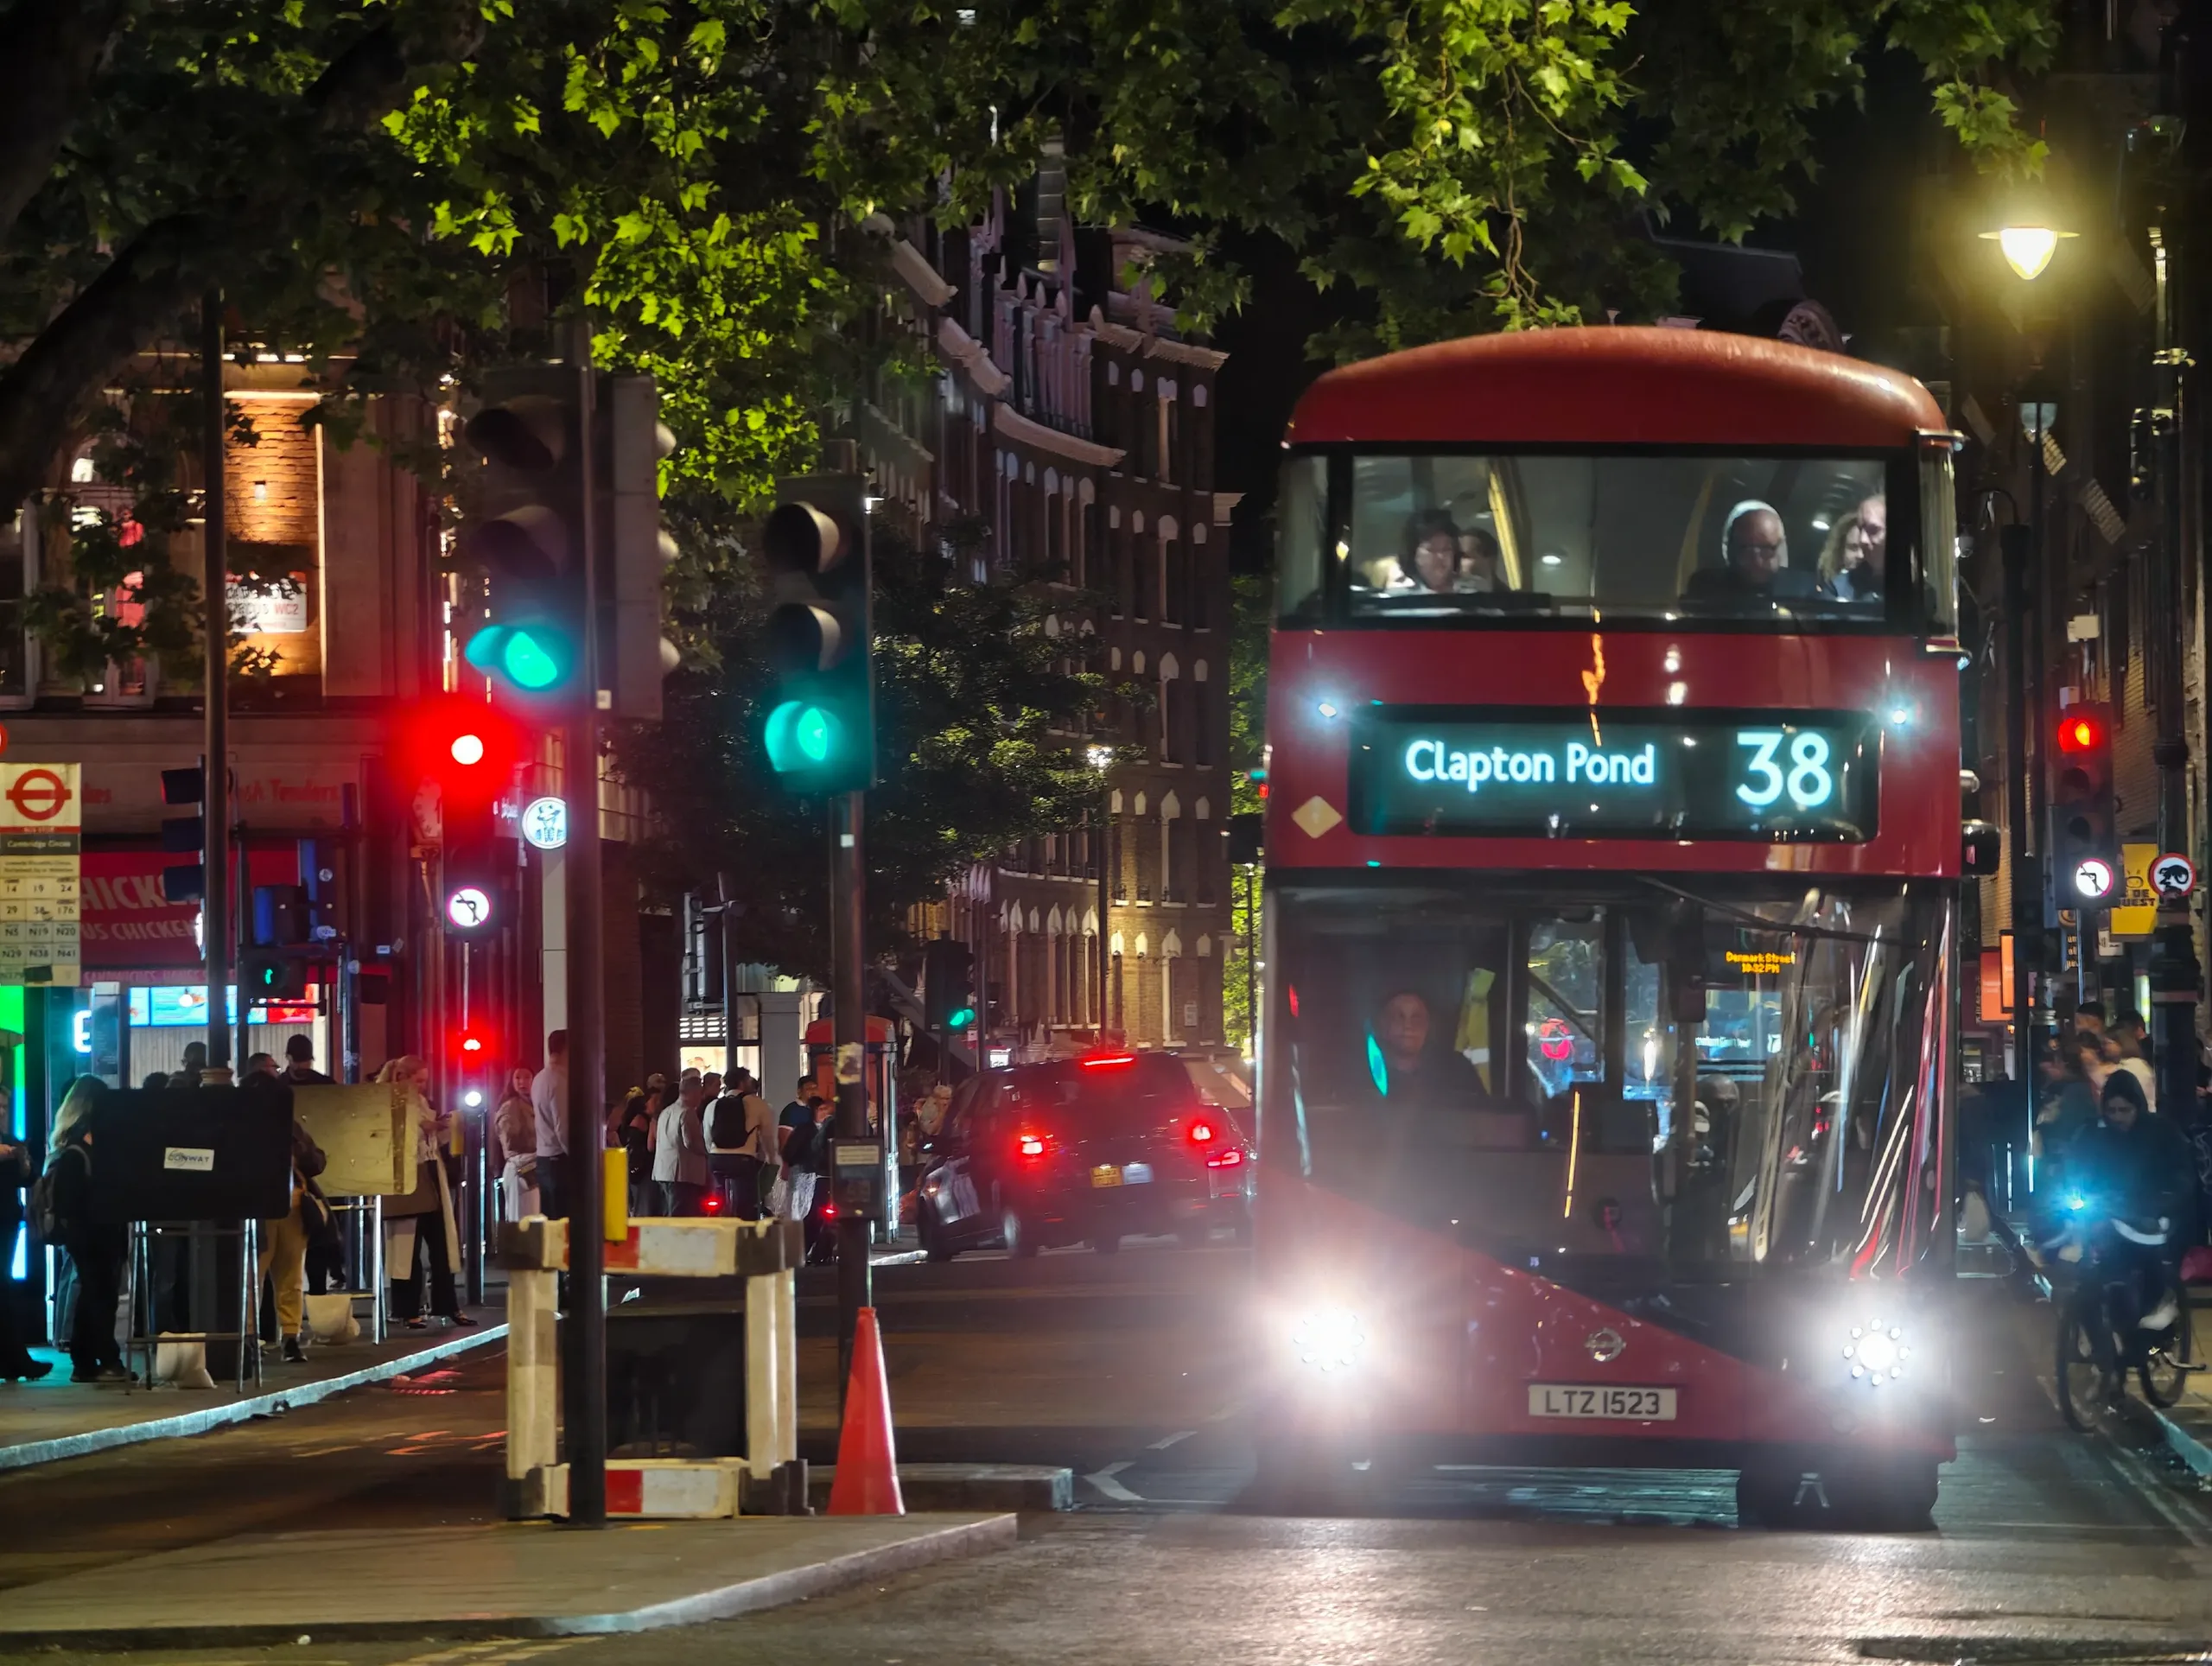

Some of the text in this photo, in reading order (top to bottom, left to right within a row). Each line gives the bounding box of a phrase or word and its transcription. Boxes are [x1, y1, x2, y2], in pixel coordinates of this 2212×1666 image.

[273, 602, 299, 615] WC2
[1405, 740, 1656, 792] Clapton Pond
[1736, 731, 1833, 807] 38
[6, 884, 72, 893] 14 19 24
[2120, 897, 2156, 907] UEST
[6, 905, 18, 914] 29
[57, 906, 74, 914] 176
[4, 926, 76, 937] N5 N19 N20
[81, 922, 110, 940] US
[57, 950, 76, 958] N41
[1726, 951, 1795, 964] Denmark Stree
[1765, 963, 1780, 974] PM
[1545, 1389, 1660, 1415] LTZ 1523
